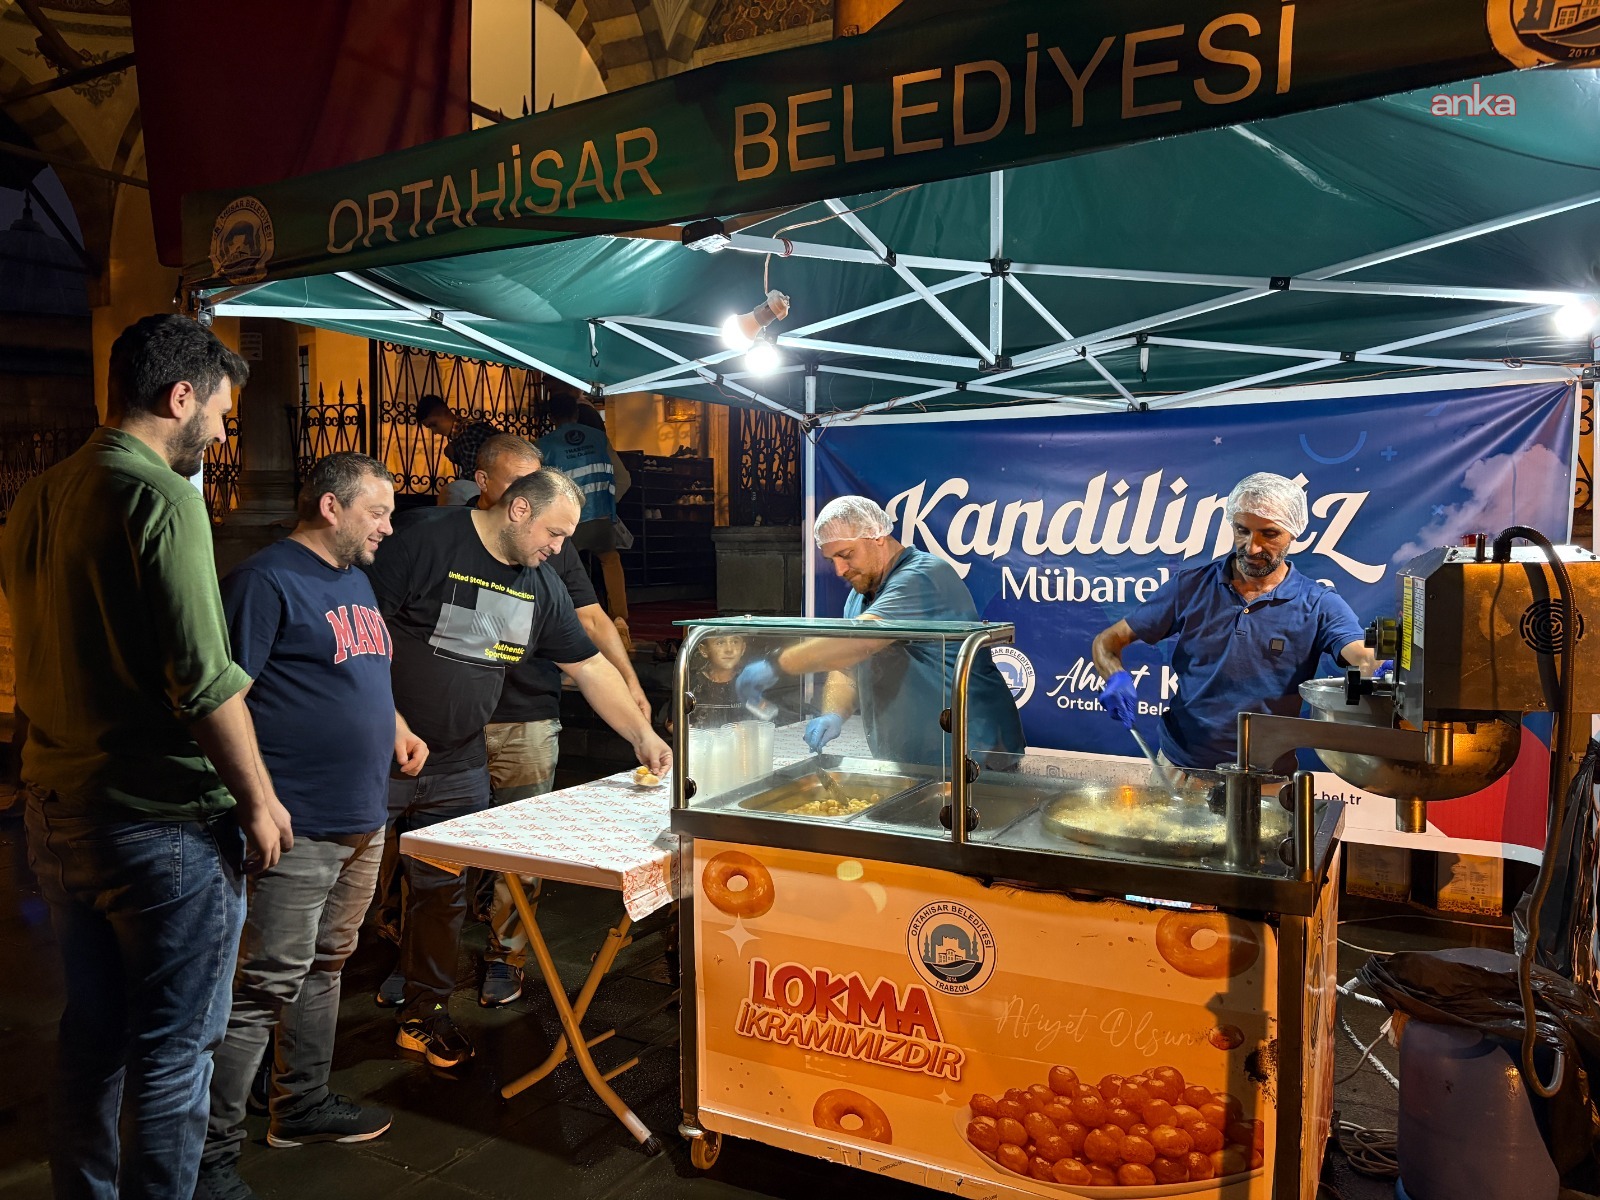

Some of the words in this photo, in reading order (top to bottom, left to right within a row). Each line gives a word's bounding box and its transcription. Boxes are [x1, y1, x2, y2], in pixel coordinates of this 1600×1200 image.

[1568, 48, 1596, 58] 2014
[327, 126, 663, 253] ORTAHİSAR
[734, 0, 1295, 182] BELEDİYESİ
[448, 571, 469, 582] United
[469, 576, 490, 588] States
[490, 581, 506, 592] Polo
[493, 642, 526, 655] Authentic
[911, 904, 949, 937] ORTAHİSAR
[951, 905, 994, 949] BELEDİYESİ
[751, 959, 943, 1043] LOKMA
[935, 979, 970, 993] TRABZON
[736, 1002, 964, 1079] İKRAMIMIZDIR
[1100, 1007, 1195, 1057] Olsun
